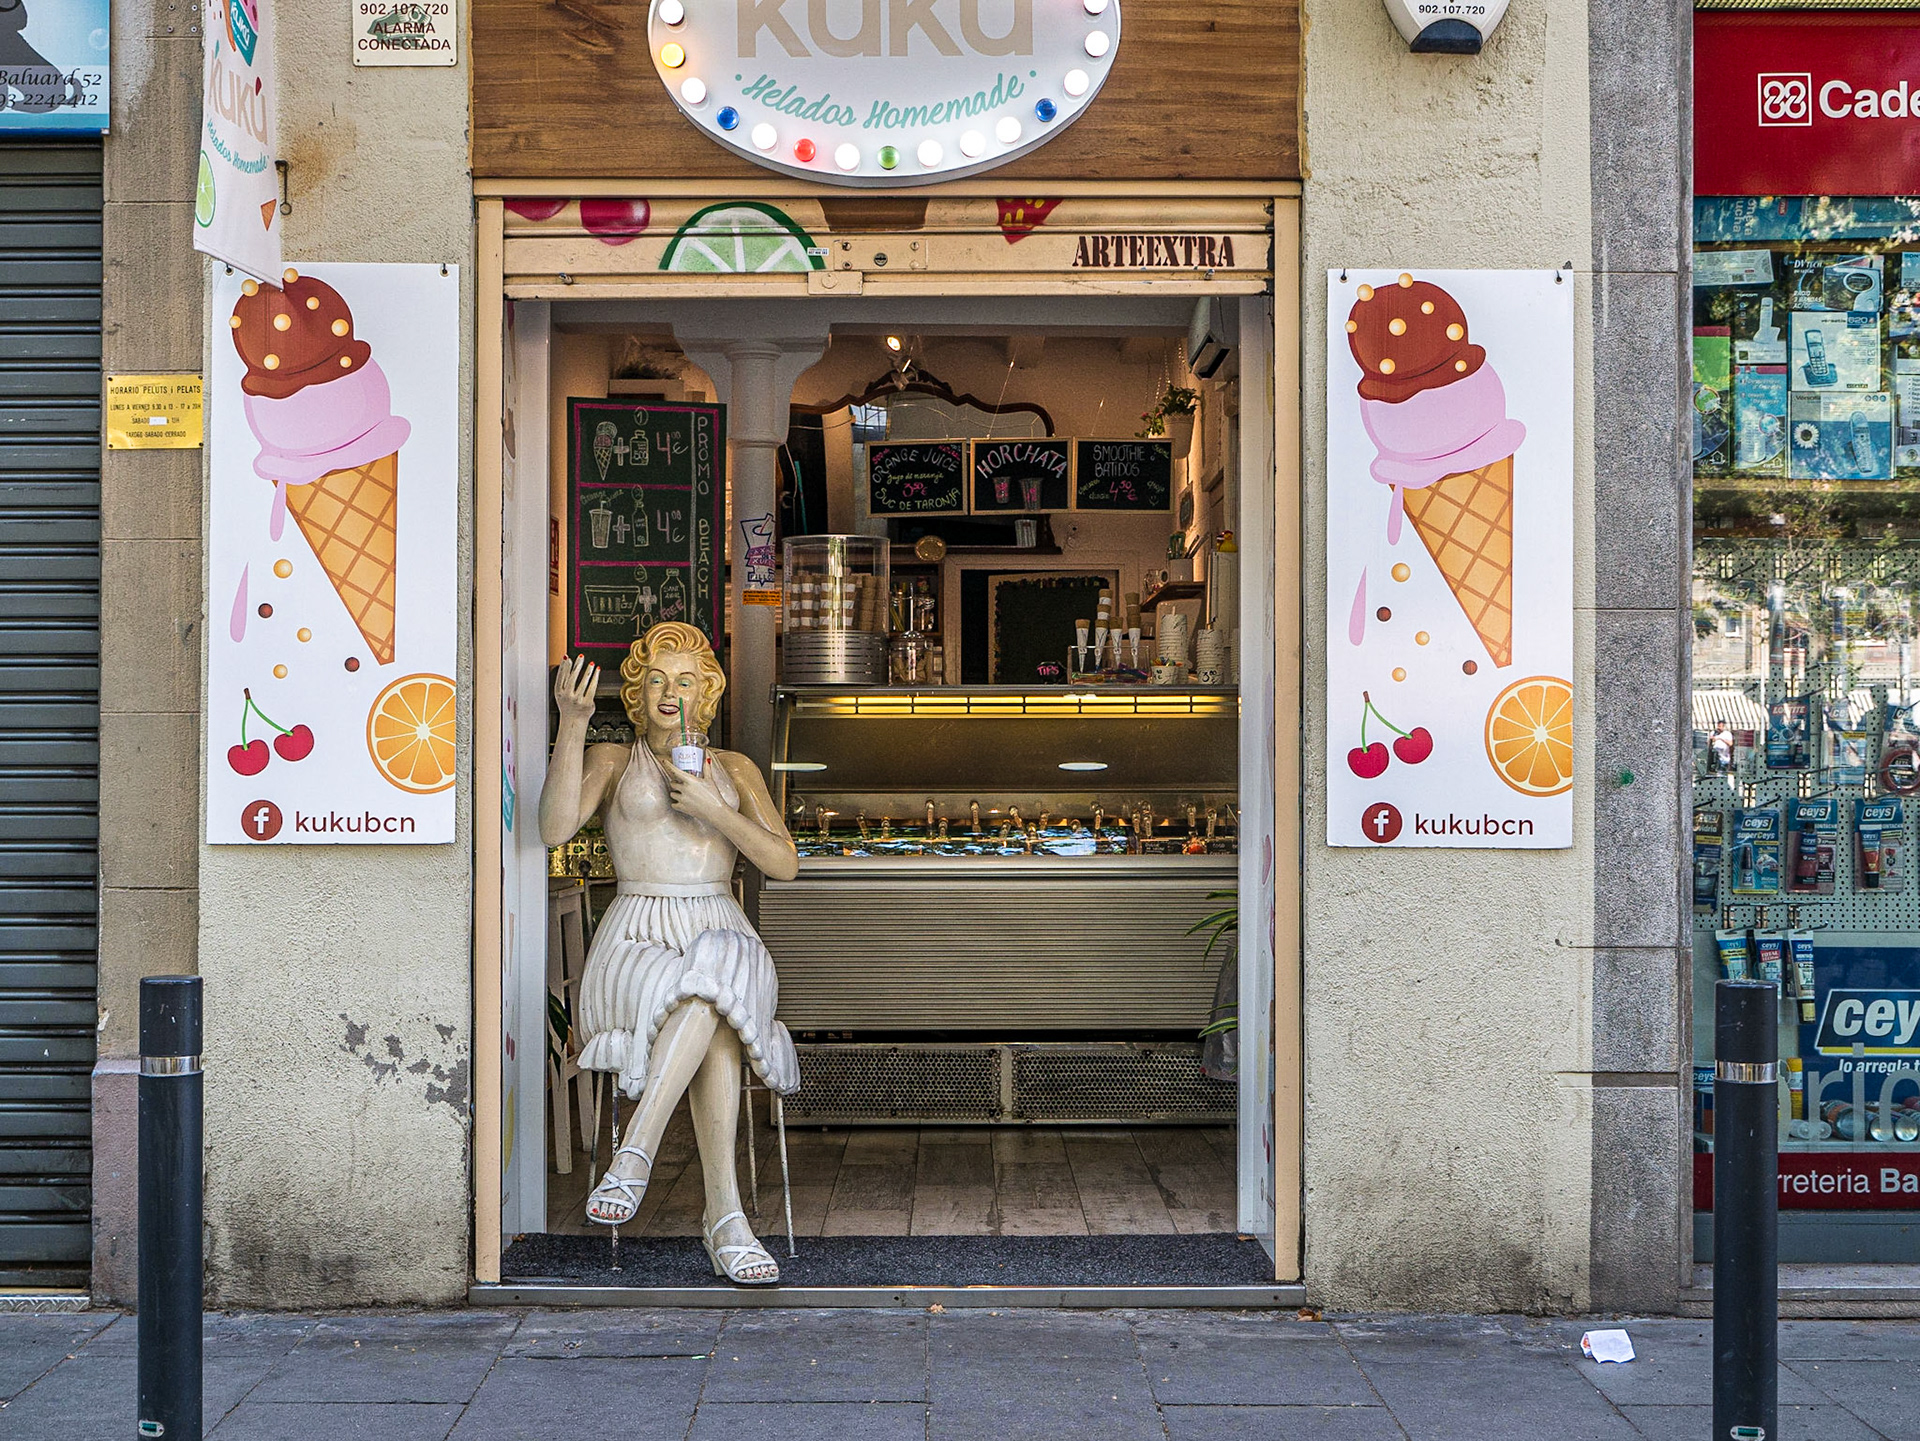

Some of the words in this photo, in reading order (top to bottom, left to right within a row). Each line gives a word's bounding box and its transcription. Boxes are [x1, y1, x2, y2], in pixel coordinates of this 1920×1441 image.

[360, 4, 449, 15] 902.107.720
[1418, 4, 1485, 15] 902.107.720
[373, 22, 436, 34] ALARMA
[358, 39, 451, 50] CONECTADA
[0, 68, 80, 86] Baluard
[81, 74, 102, 88] 52
[0, 94, 16, 109] 93
[23, 94, 98, 108] 2242412
[741, 74, 857, 127] Helados
[863, 73, 1025, 129] Homemade
[1072, 235, 1235, 267] ARTEEXTRA
[176, 386, 201, 394] PELATS
[922, 448, 959, 472] JUICE
[977, 443, 1067, 479] HORCHATA
[899, 501, 912, 510] DE
[1800, 807, 1826, 818] ceys
[1865, 807, 1892, 818] ceys
[295, 811, 415, 832] kukubcn
[1415, 814, 1533, 835] kukubcn
[1745, 819, 1769, 828] ceys
